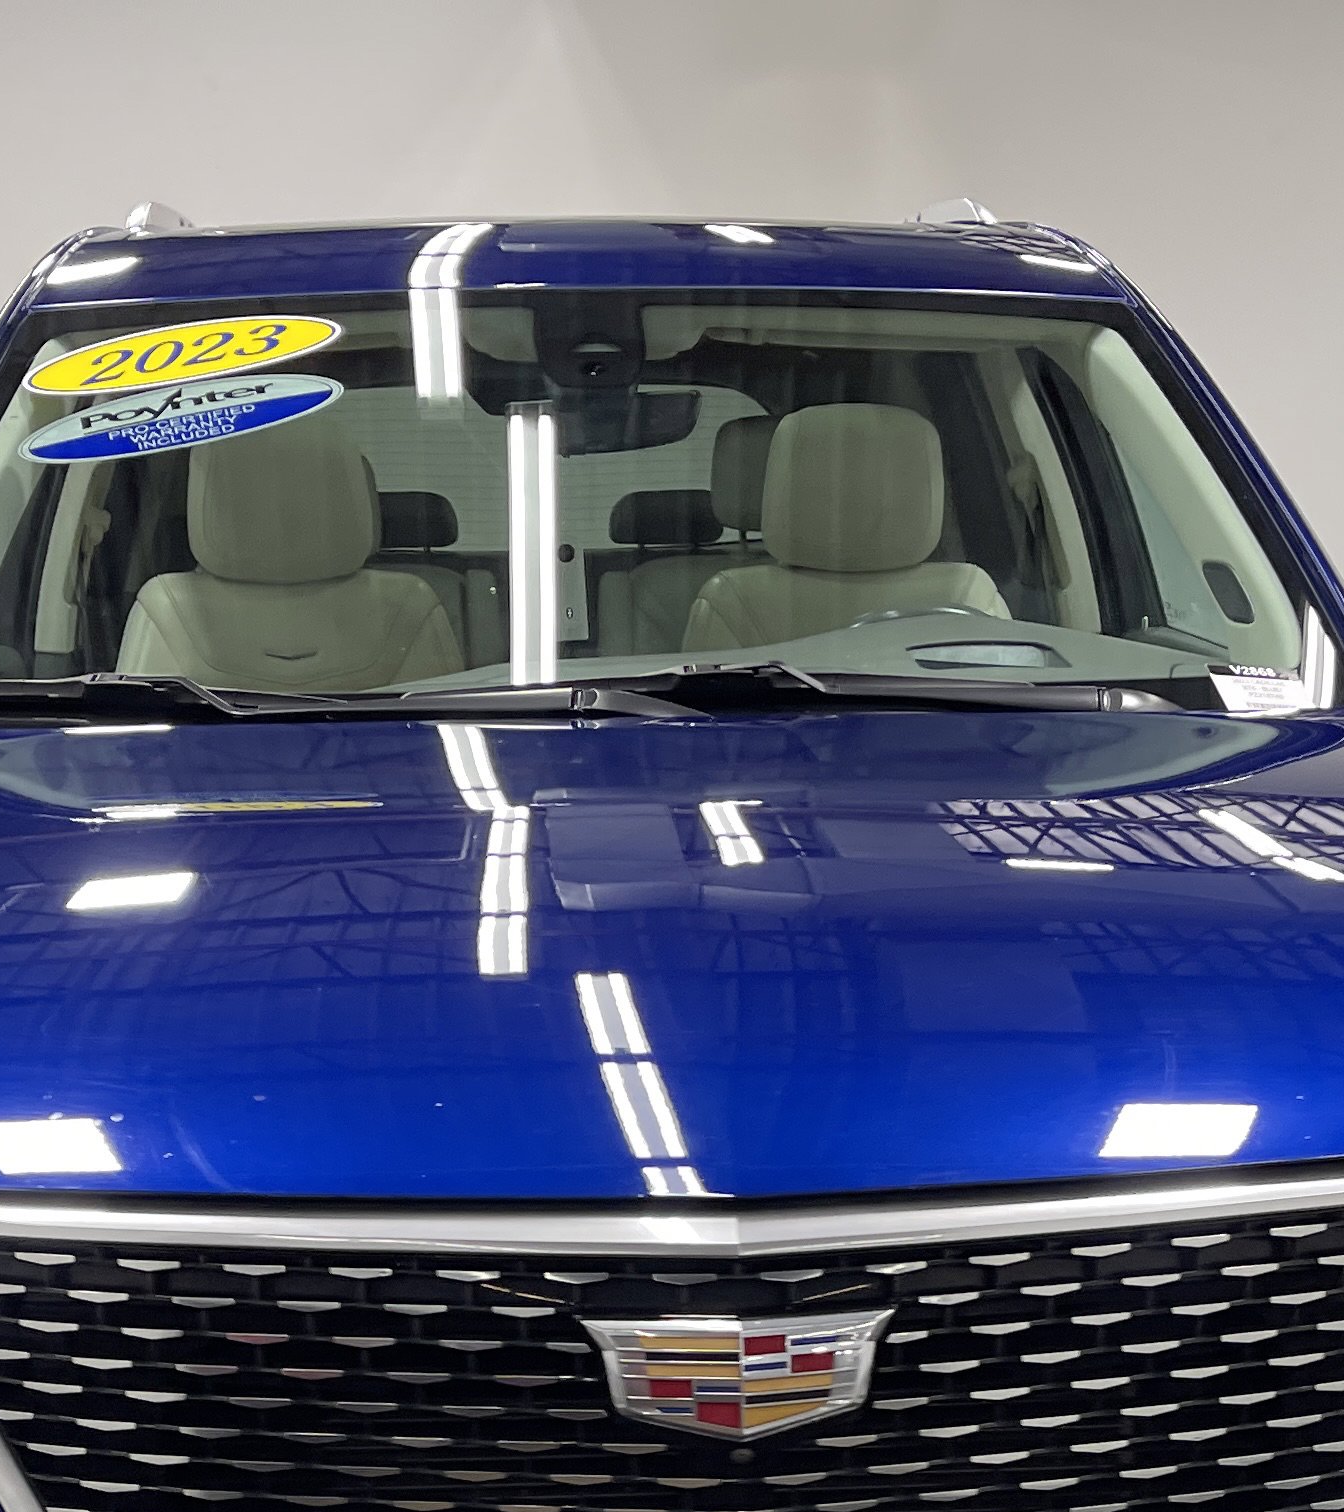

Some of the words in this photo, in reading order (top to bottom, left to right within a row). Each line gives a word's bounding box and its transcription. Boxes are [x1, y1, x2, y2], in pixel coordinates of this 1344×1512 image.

[80, 324, 287, 386] 2023
[108, 404, 256, 440] PRO-CERTIFIED
[129, 415, 238, 443] WARRANTY
[137, 424, 236, 450] INCLUDED
